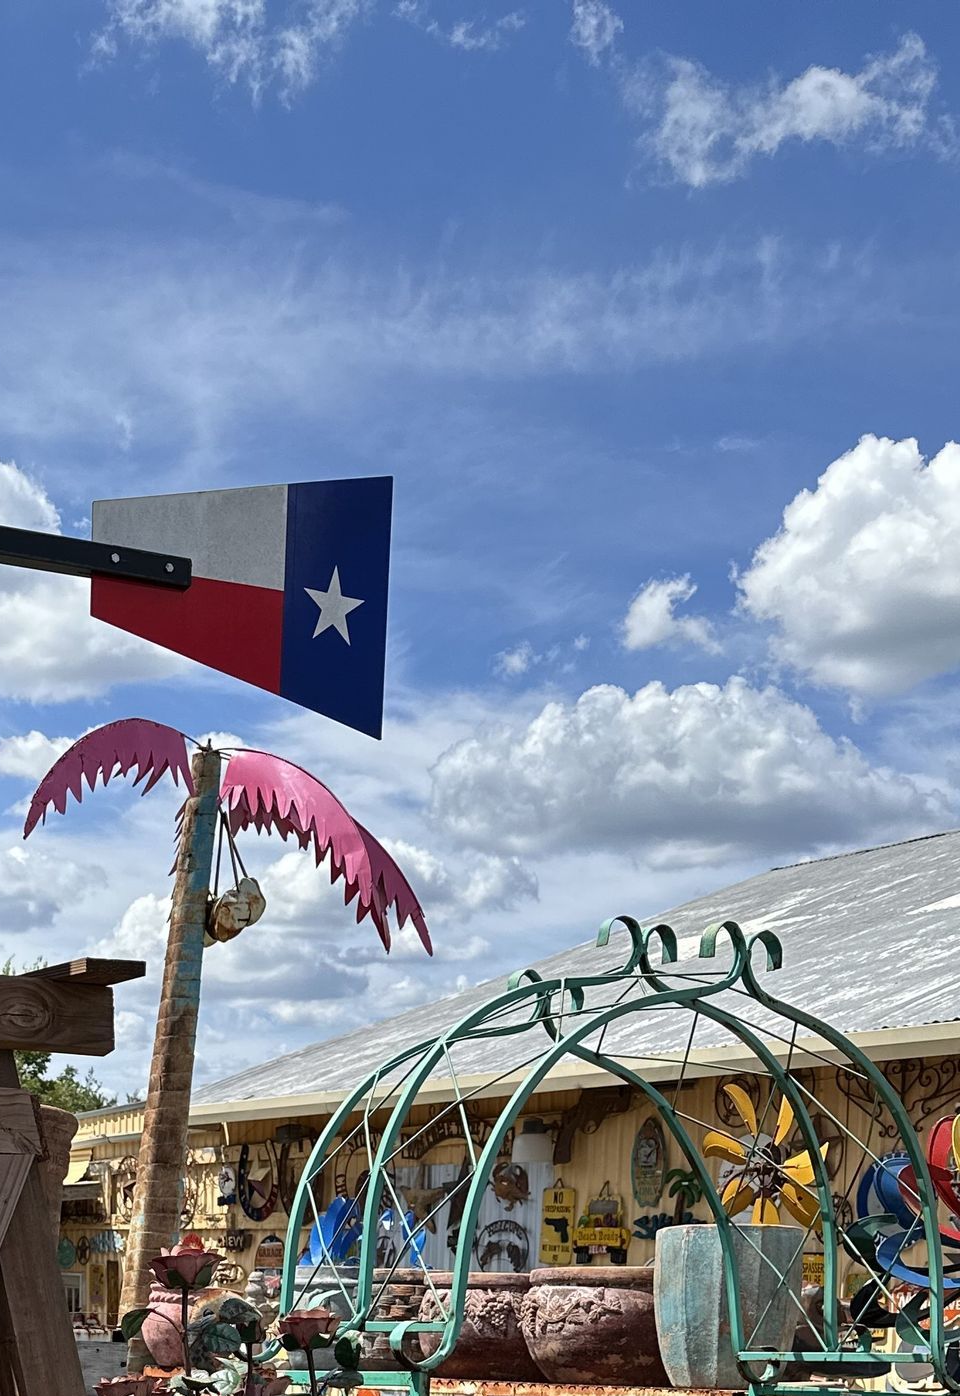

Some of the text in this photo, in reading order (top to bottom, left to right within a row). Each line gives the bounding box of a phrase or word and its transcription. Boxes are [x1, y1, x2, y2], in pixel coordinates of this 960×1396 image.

[553, 1192, 563, 1204] NO
[545, 1205, 571, 1213] TRESPASSING
[218, 1235, 244, 1248] CHEVY
[578, 1231, 619, 1242] Beach Ready
[258, 1247, 283, 1257] GARAGE
[589, 1245, 608, 1254] RELAX
